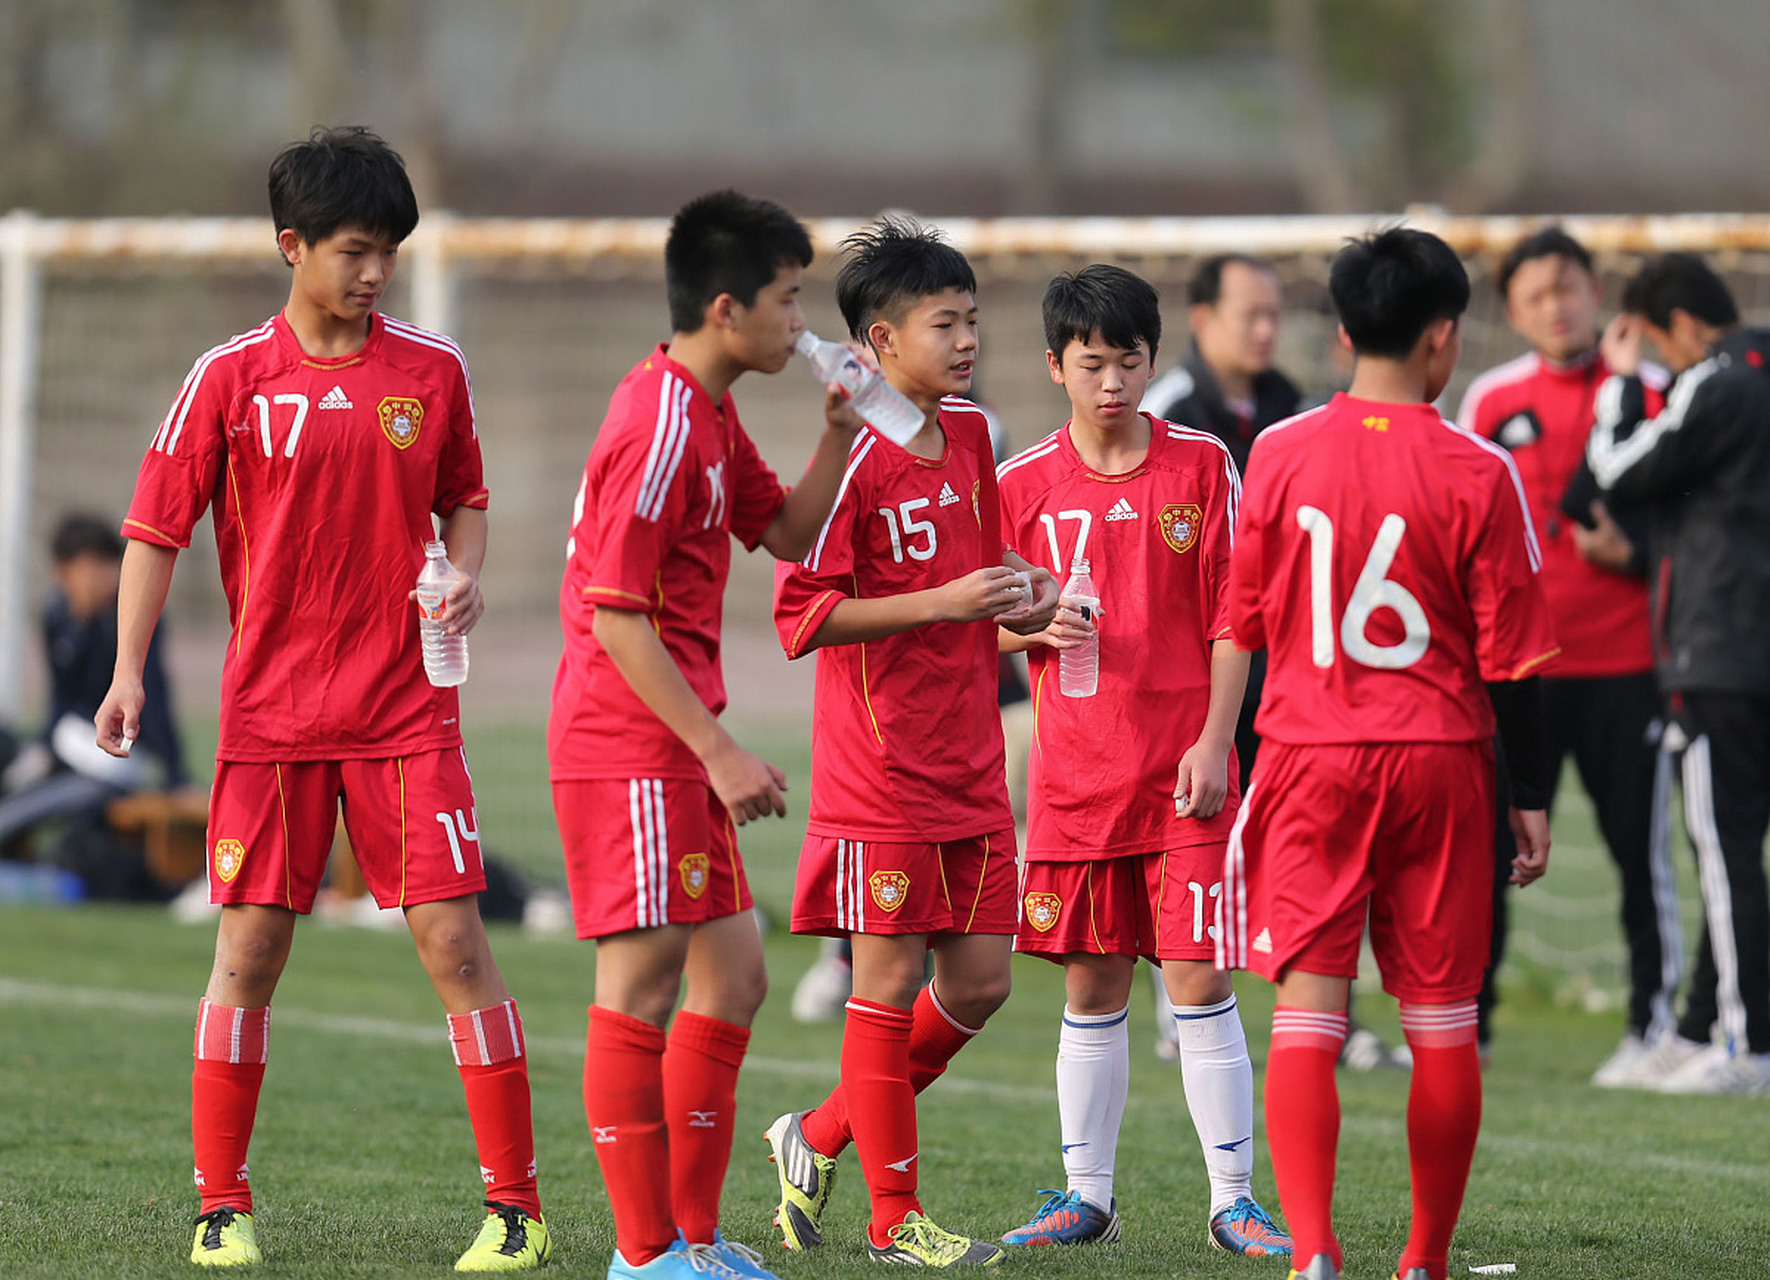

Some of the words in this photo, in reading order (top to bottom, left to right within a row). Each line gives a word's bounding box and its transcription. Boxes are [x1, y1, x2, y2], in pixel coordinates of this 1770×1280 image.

[253, 393, 310, 458] 17
[318, 399, 354, 410] adidas
[879, 497, 937, 563] 15
[1040, 509, 1092, 574] 17
[1104, 511, 1139, 522] adidas
[1297, 505, 1431, 669] 16
[436, 807, 484, 874] 14
